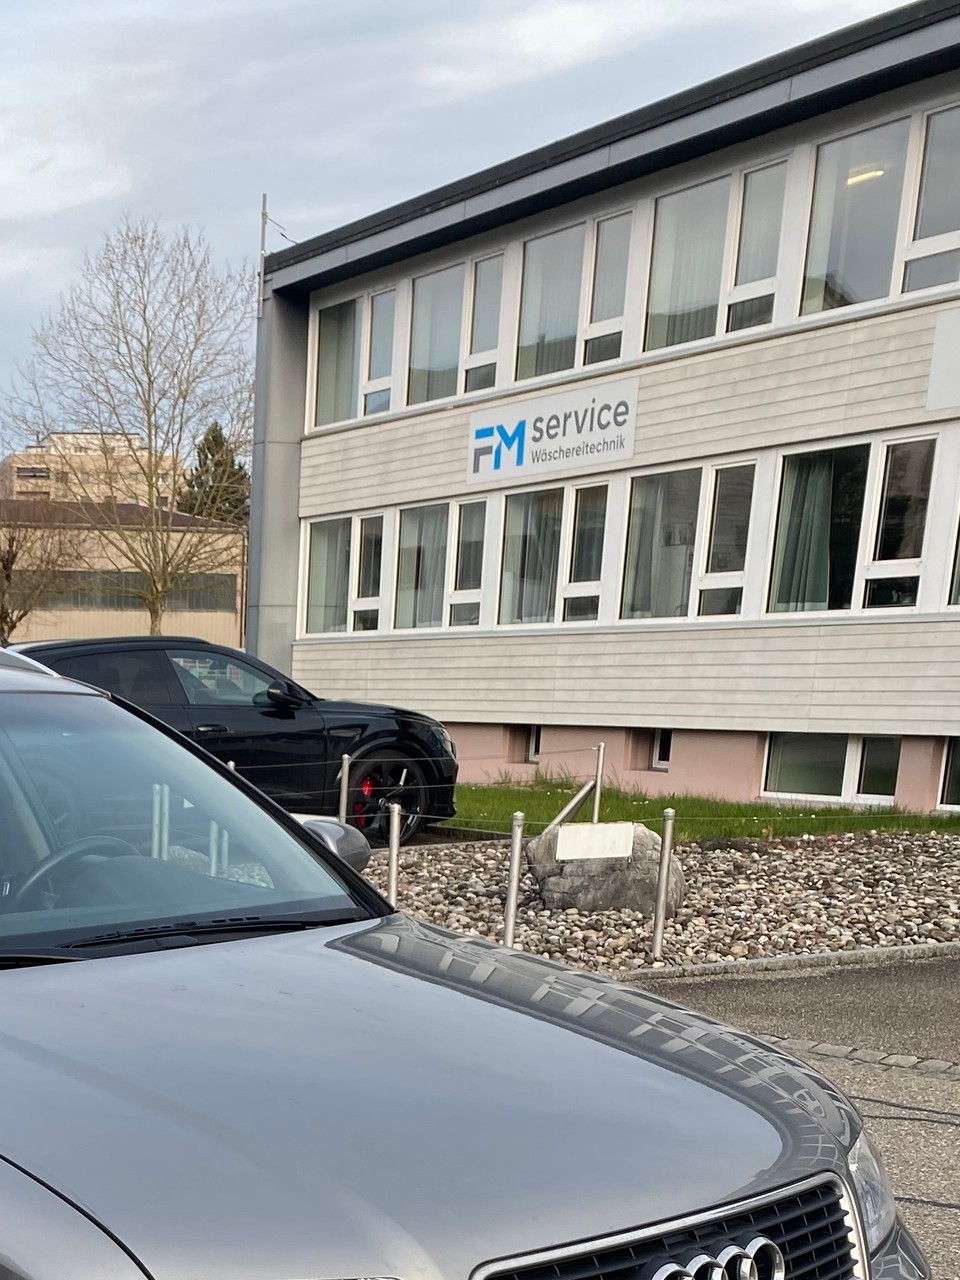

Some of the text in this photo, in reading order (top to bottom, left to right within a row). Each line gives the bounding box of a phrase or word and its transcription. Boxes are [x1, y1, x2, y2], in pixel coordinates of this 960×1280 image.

[472, 397, 630, 474] FM service
[531, 435, 626, 464] Wäschereitechnik
